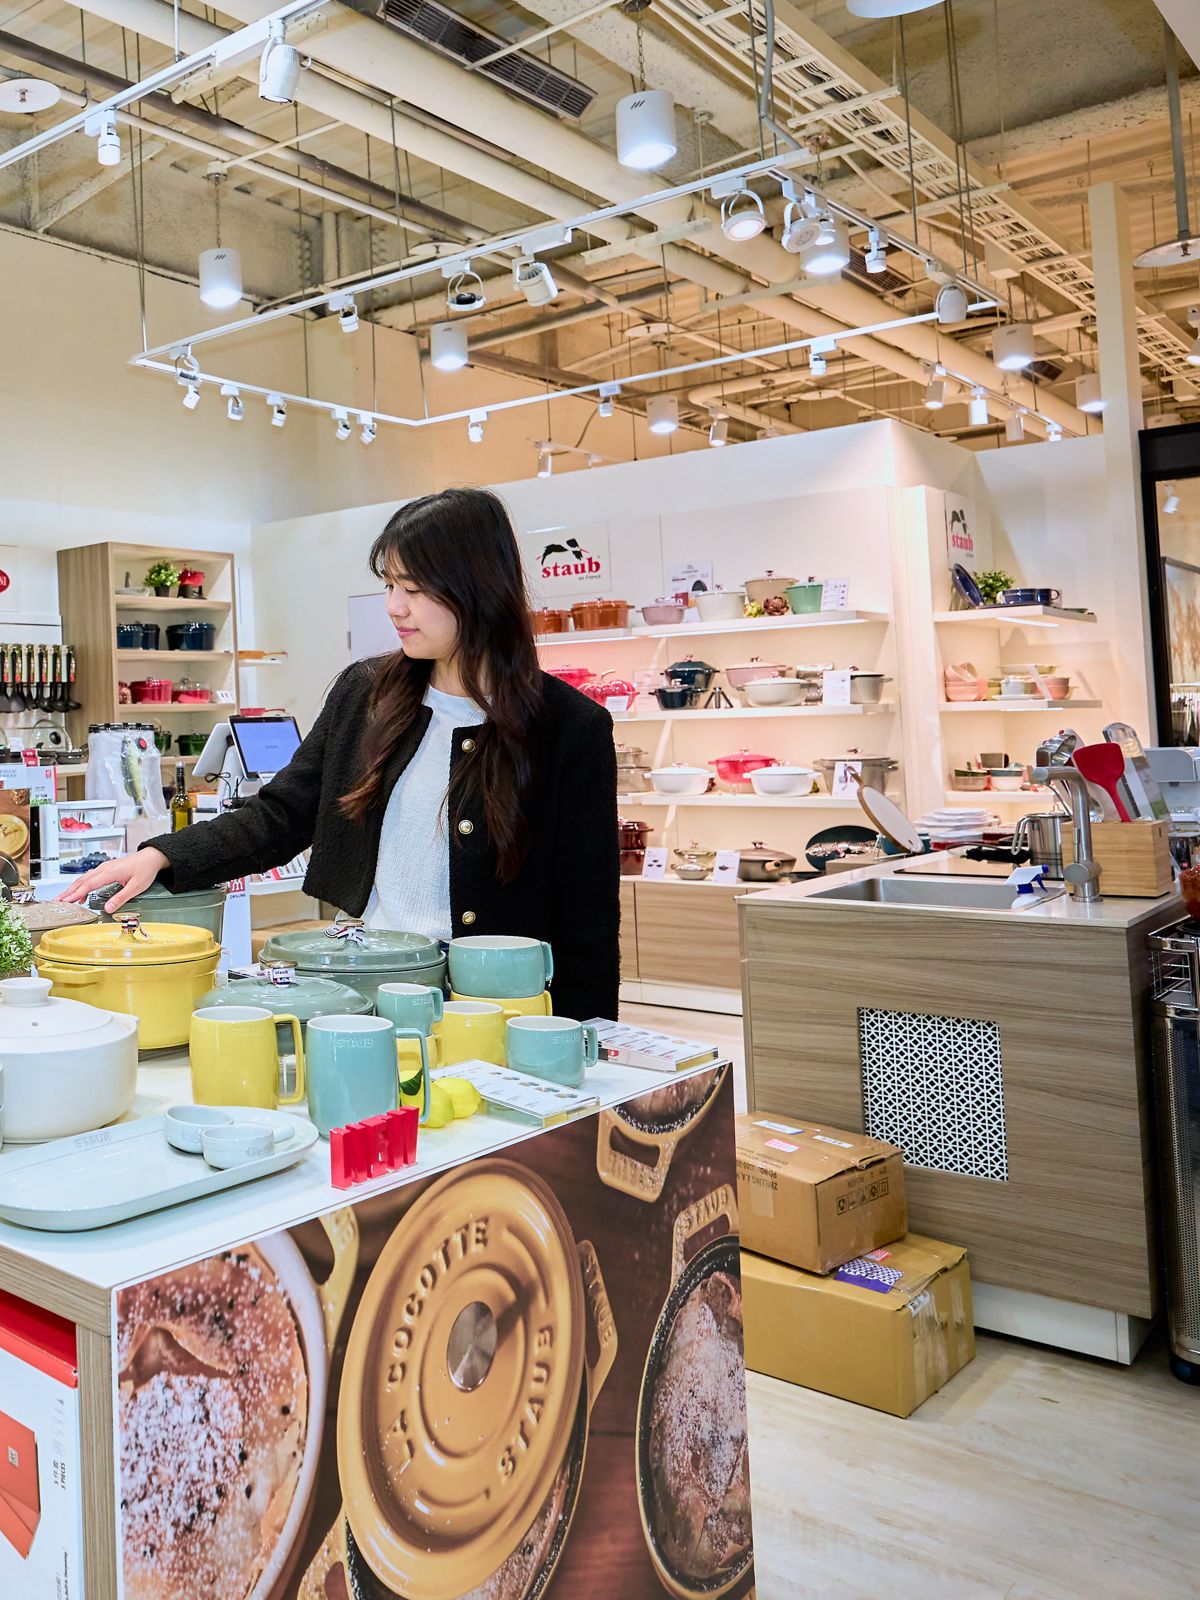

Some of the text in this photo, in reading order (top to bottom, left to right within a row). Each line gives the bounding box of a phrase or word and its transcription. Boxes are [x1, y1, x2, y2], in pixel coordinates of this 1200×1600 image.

[951, 531, 974, 551] staub
[541, 556, 601, 578] staub
[413, 996, 433, 1006] STAU
[336, 1037, 375, 1048] STAUB
[73, 1132, 113, 1149] STAUB
[384, 1216, 490, 1393] COCOTTE
[497, 1323, 555, 1482] STAUB
